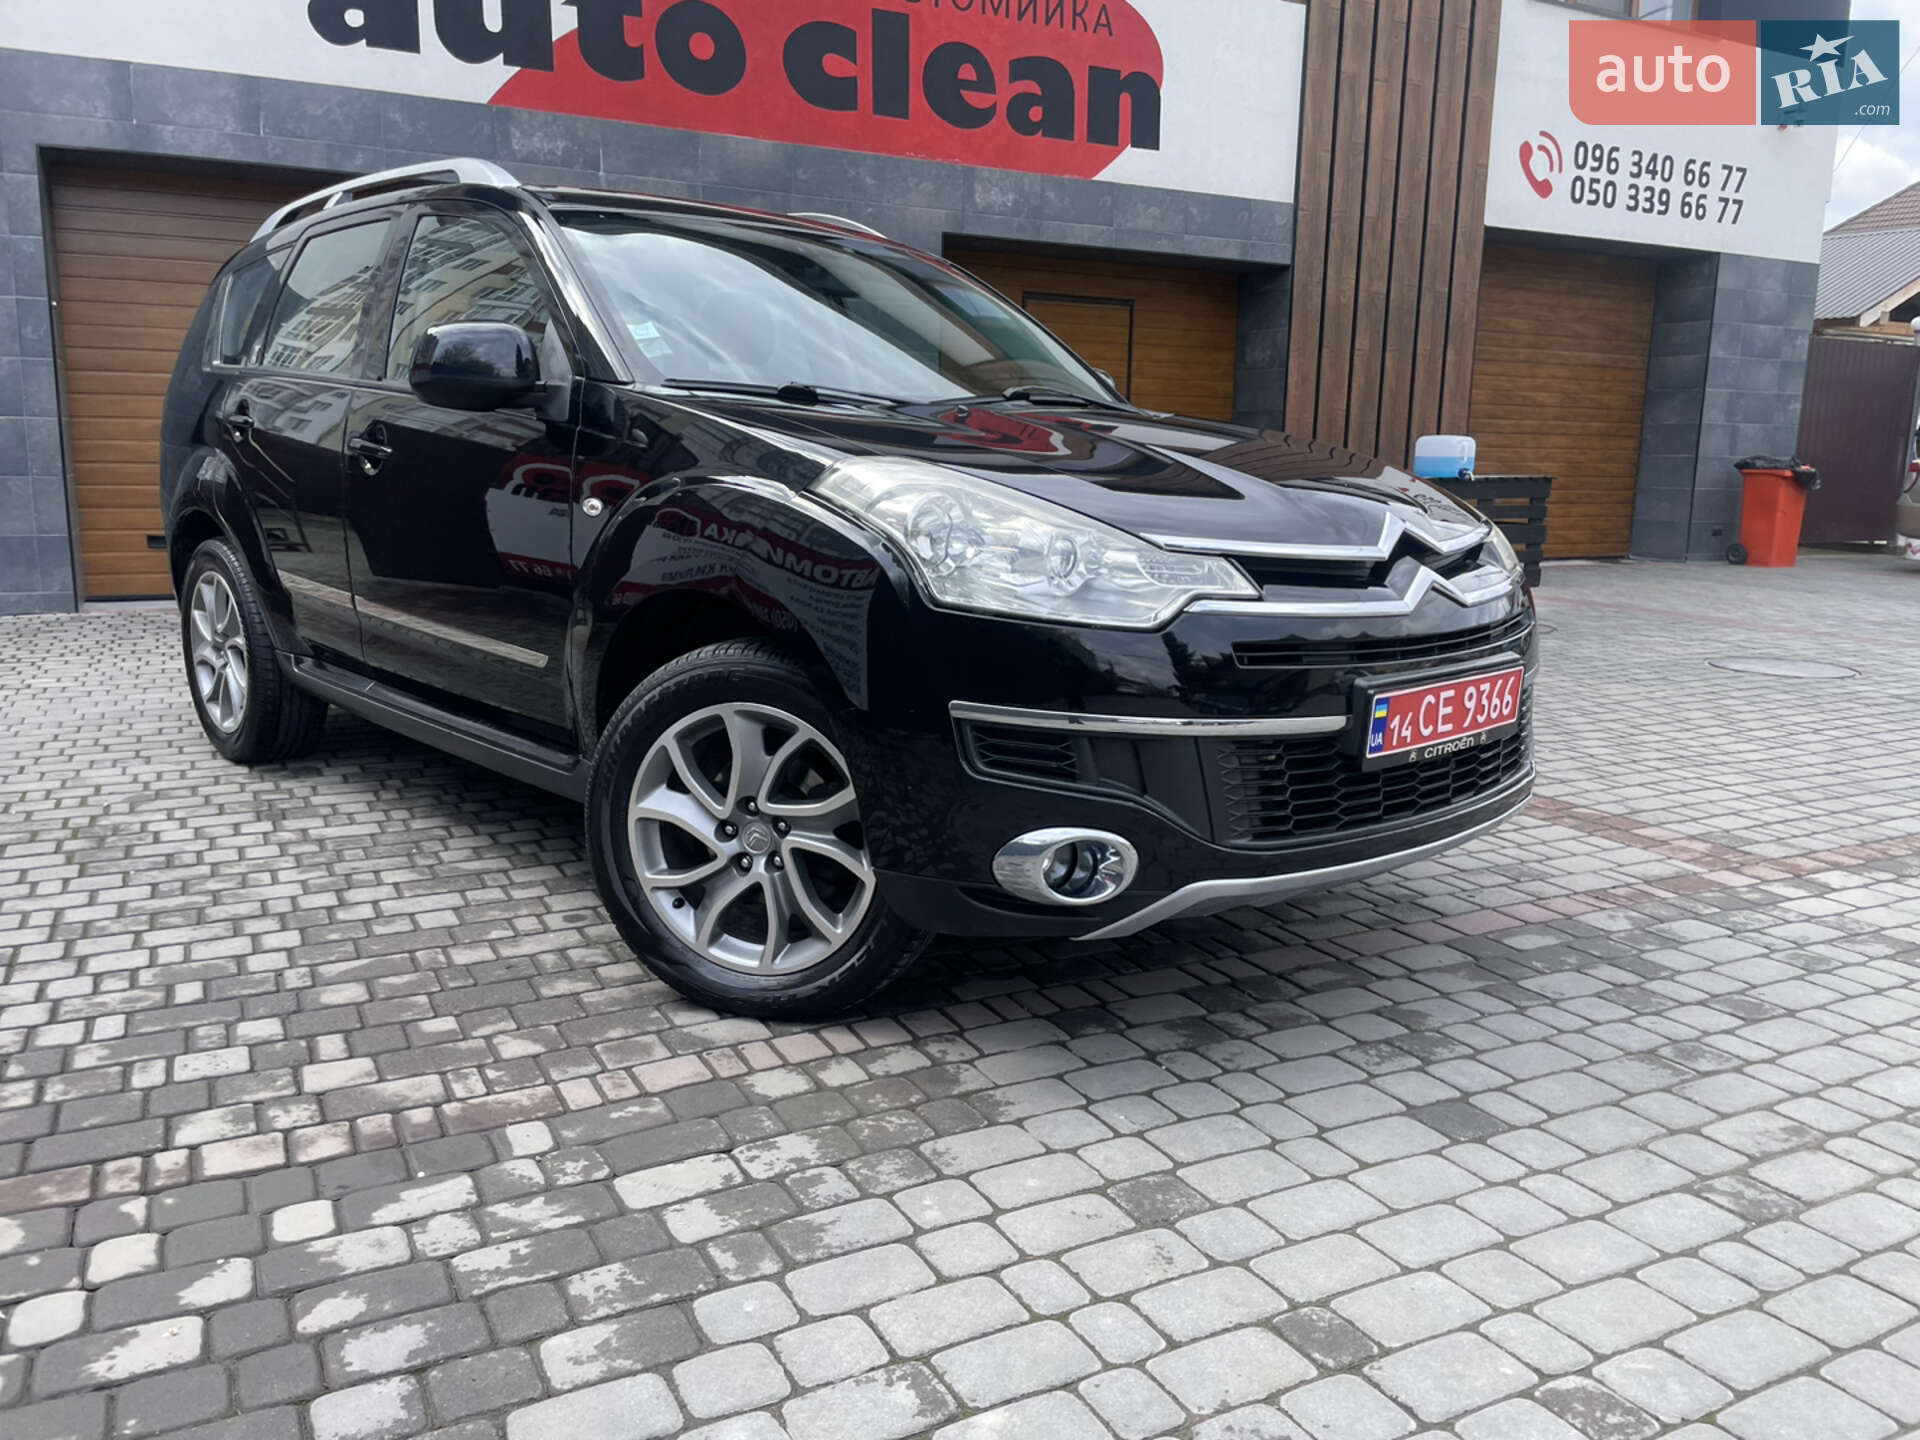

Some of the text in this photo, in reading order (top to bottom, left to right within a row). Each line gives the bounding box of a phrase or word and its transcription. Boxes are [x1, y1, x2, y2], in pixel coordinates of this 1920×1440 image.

[307, 0, 1162, 152] auto clean
[1574, 140, 1748, 193] 096 340 66 77
[1570, 175, 1744, 225] 050 339 66 77
[1390, 676, 1516, 746] 14 CE 9366
[1370, 734, 1383, 747] UA
